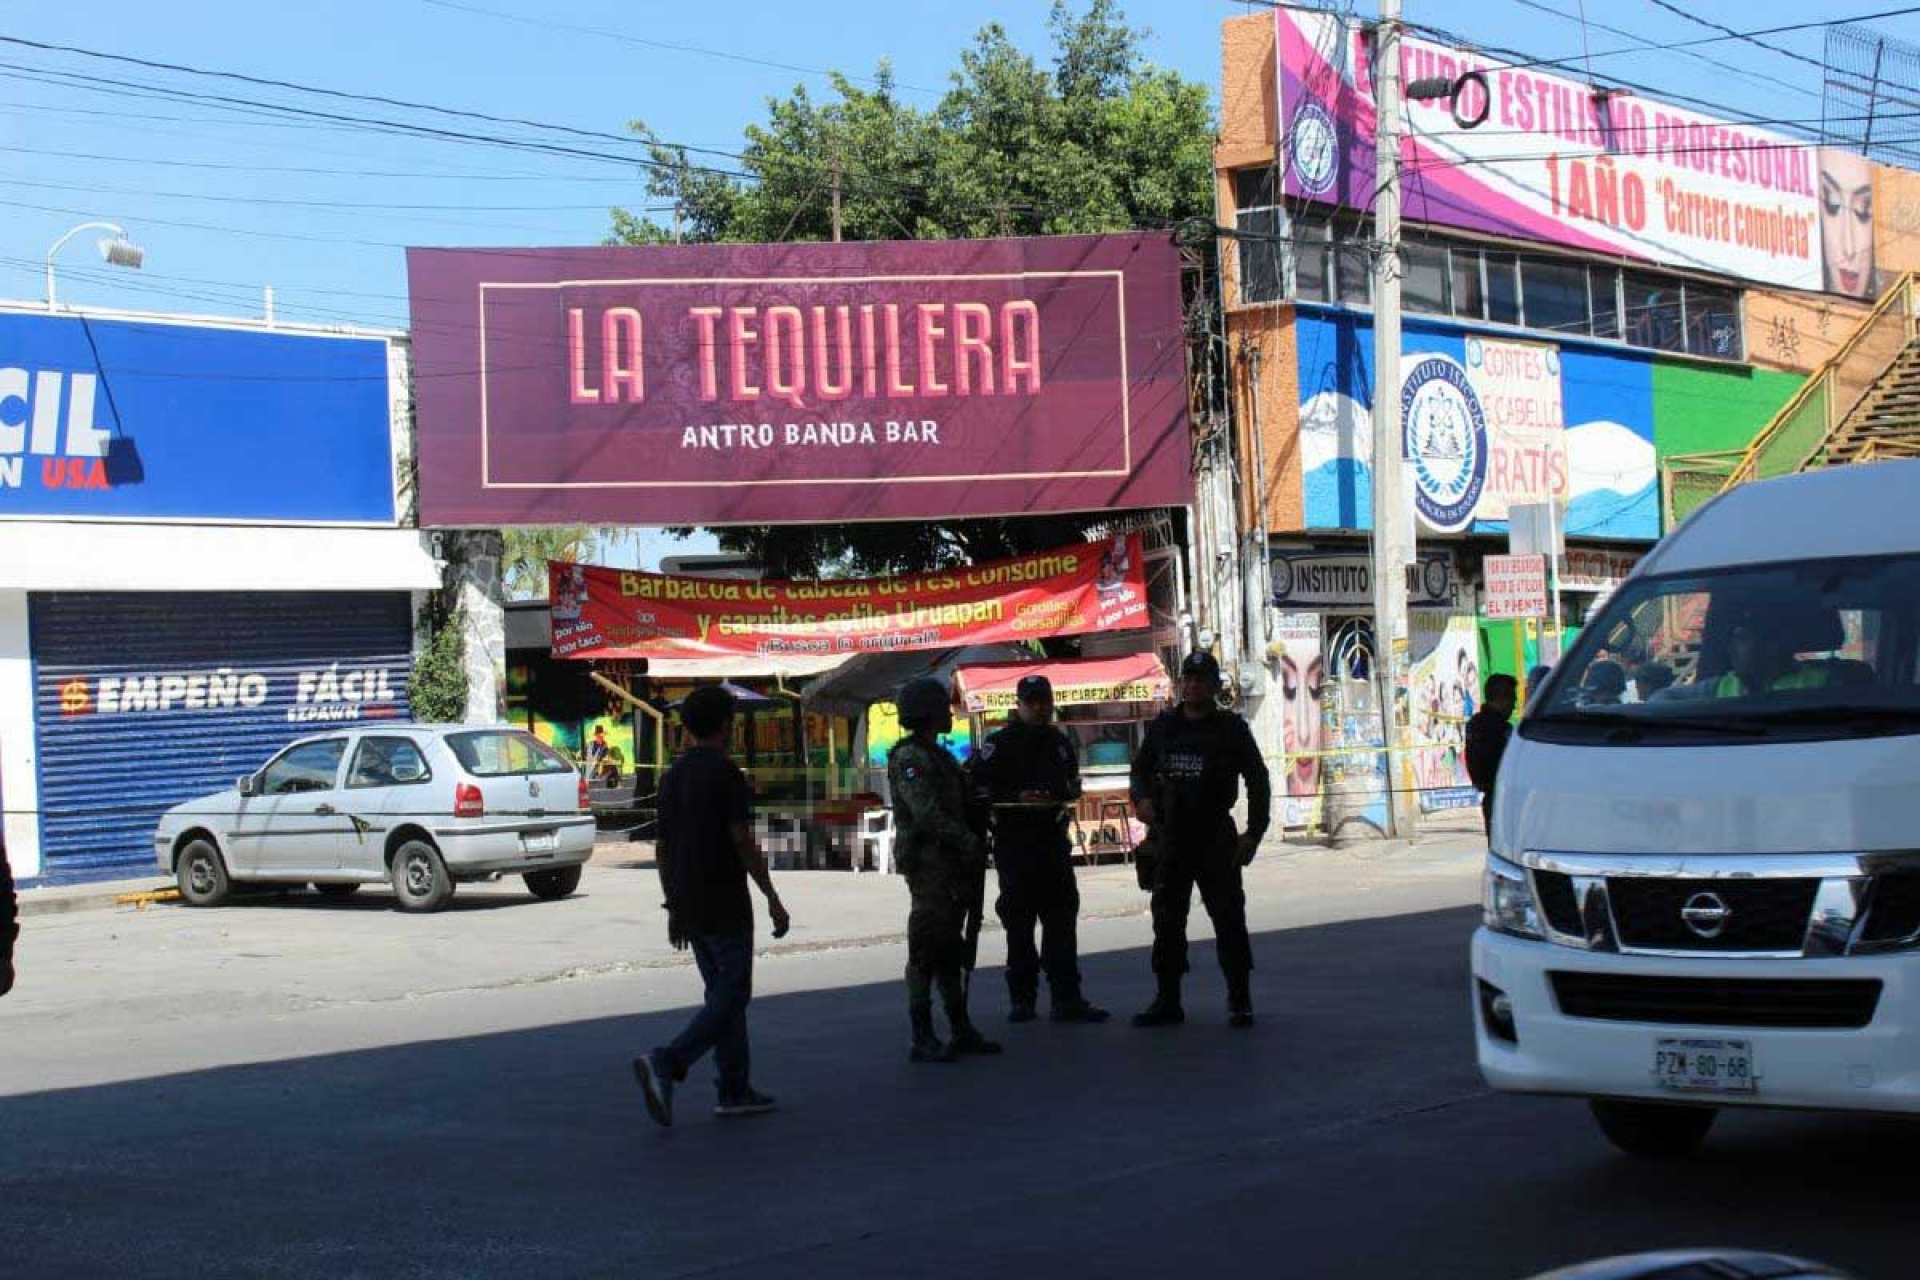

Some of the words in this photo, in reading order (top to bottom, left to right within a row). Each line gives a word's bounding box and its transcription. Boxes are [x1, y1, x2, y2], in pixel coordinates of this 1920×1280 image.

[1355, 30, 1490, 123] ETUDIO
[1499, 71, 1648, 157] ESTILISMO
[1655, 112, 1815, 198] PROFESIONAL
[1545, 152, 1559, 215] 1
[1568, 154, 1645, 231] AÑO
[568, 306, 644, 404] LA
[689, 299, 1041, 408] TEQUILERA
[1485, 346, 1542, 382] CORTES
[0, 367, 111, 457] CIL
[681, 424, 774, 450] ANTRO
[784, 421, 876, 447] BANDA
[885, 420, 940, 444] BAR
[43, 457, 109, 490] USA
[1296, 564, 1369, 593] INSTITUTO
[697, 612, 710, 643] y
[719, 606, 818, 635] carnitas
[896, 598, 1003, 631] Uruapan
[1489, 601, 1500, 614] EL
[97, 668, 268, 712] EMPEÑO
[297, 662, 395, 702] FÁCIL
